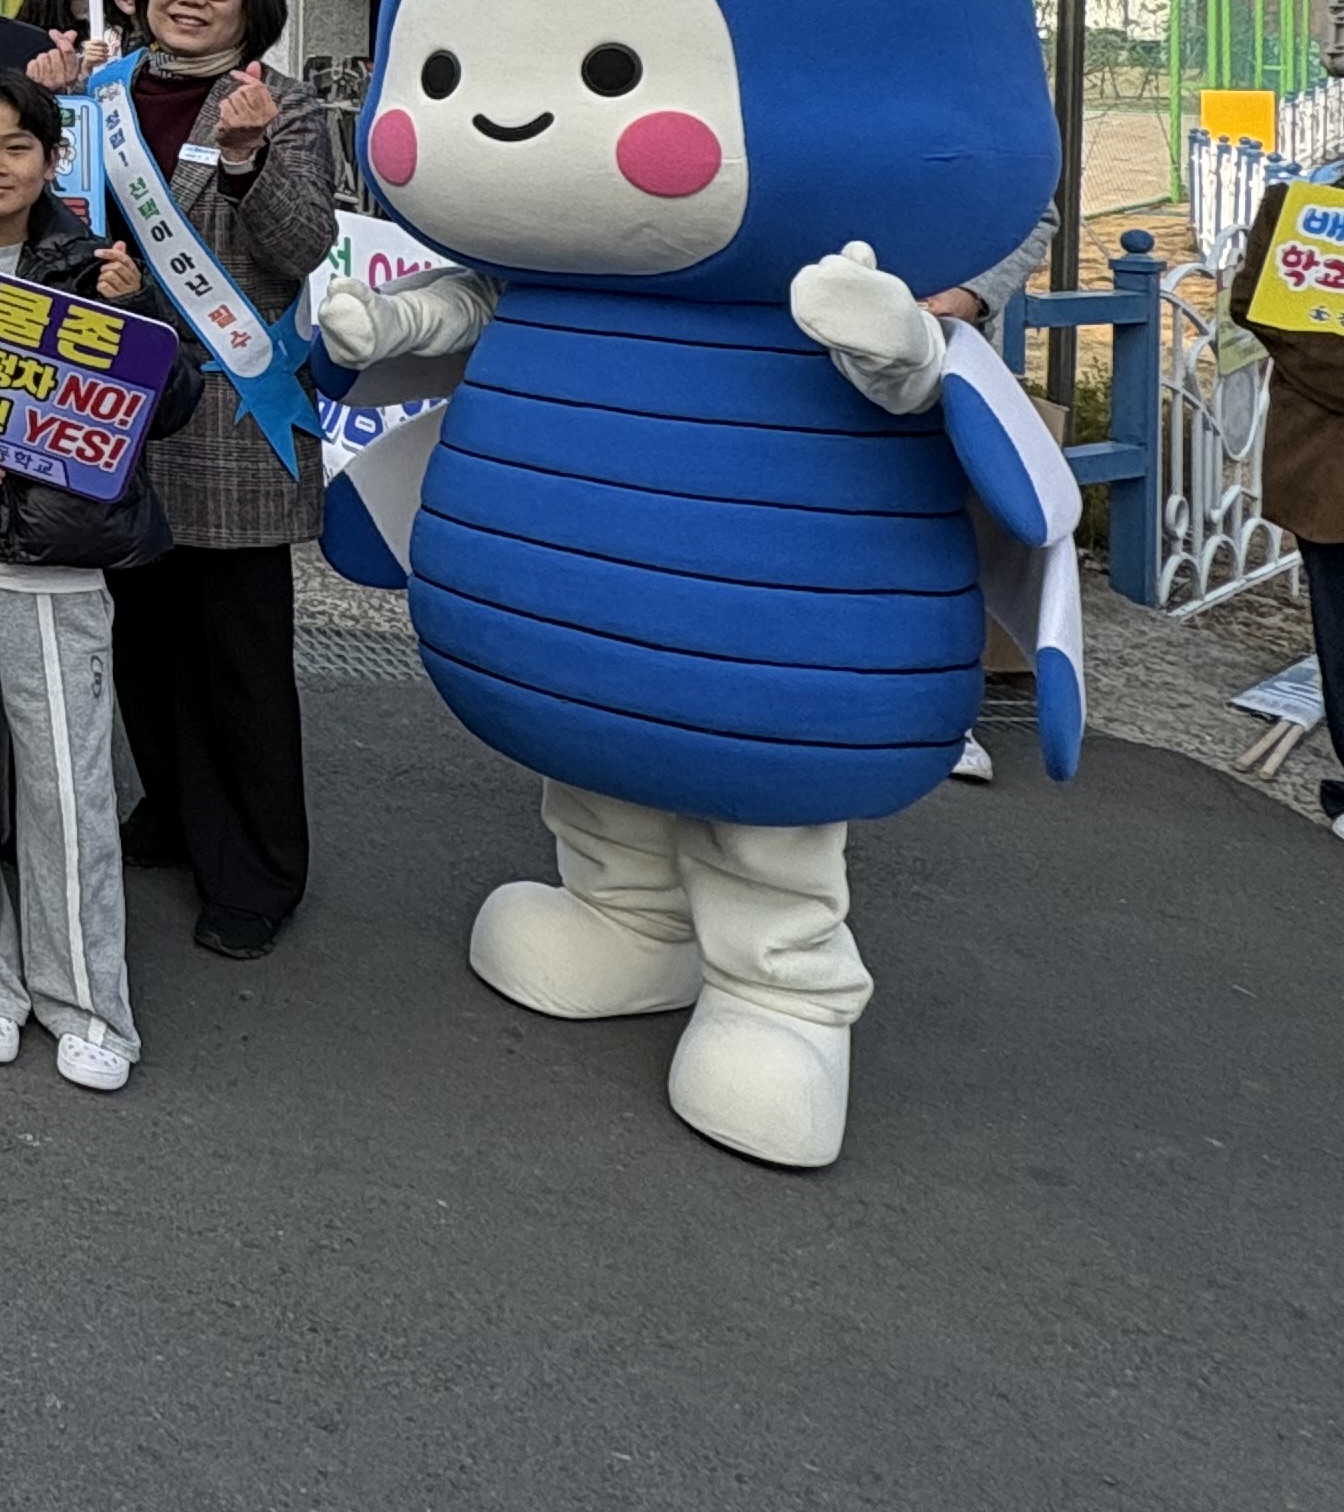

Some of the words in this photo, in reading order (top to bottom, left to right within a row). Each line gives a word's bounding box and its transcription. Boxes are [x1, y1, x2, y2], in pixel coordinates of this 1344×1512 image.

[128, 176, 174, 243] 선택이
[169, 251, 213, 298] 아닌
[207, 303, 253, 350] 필수
[58, 373, 145, 428] NO!
[25, 408, 129, 471] YES!
